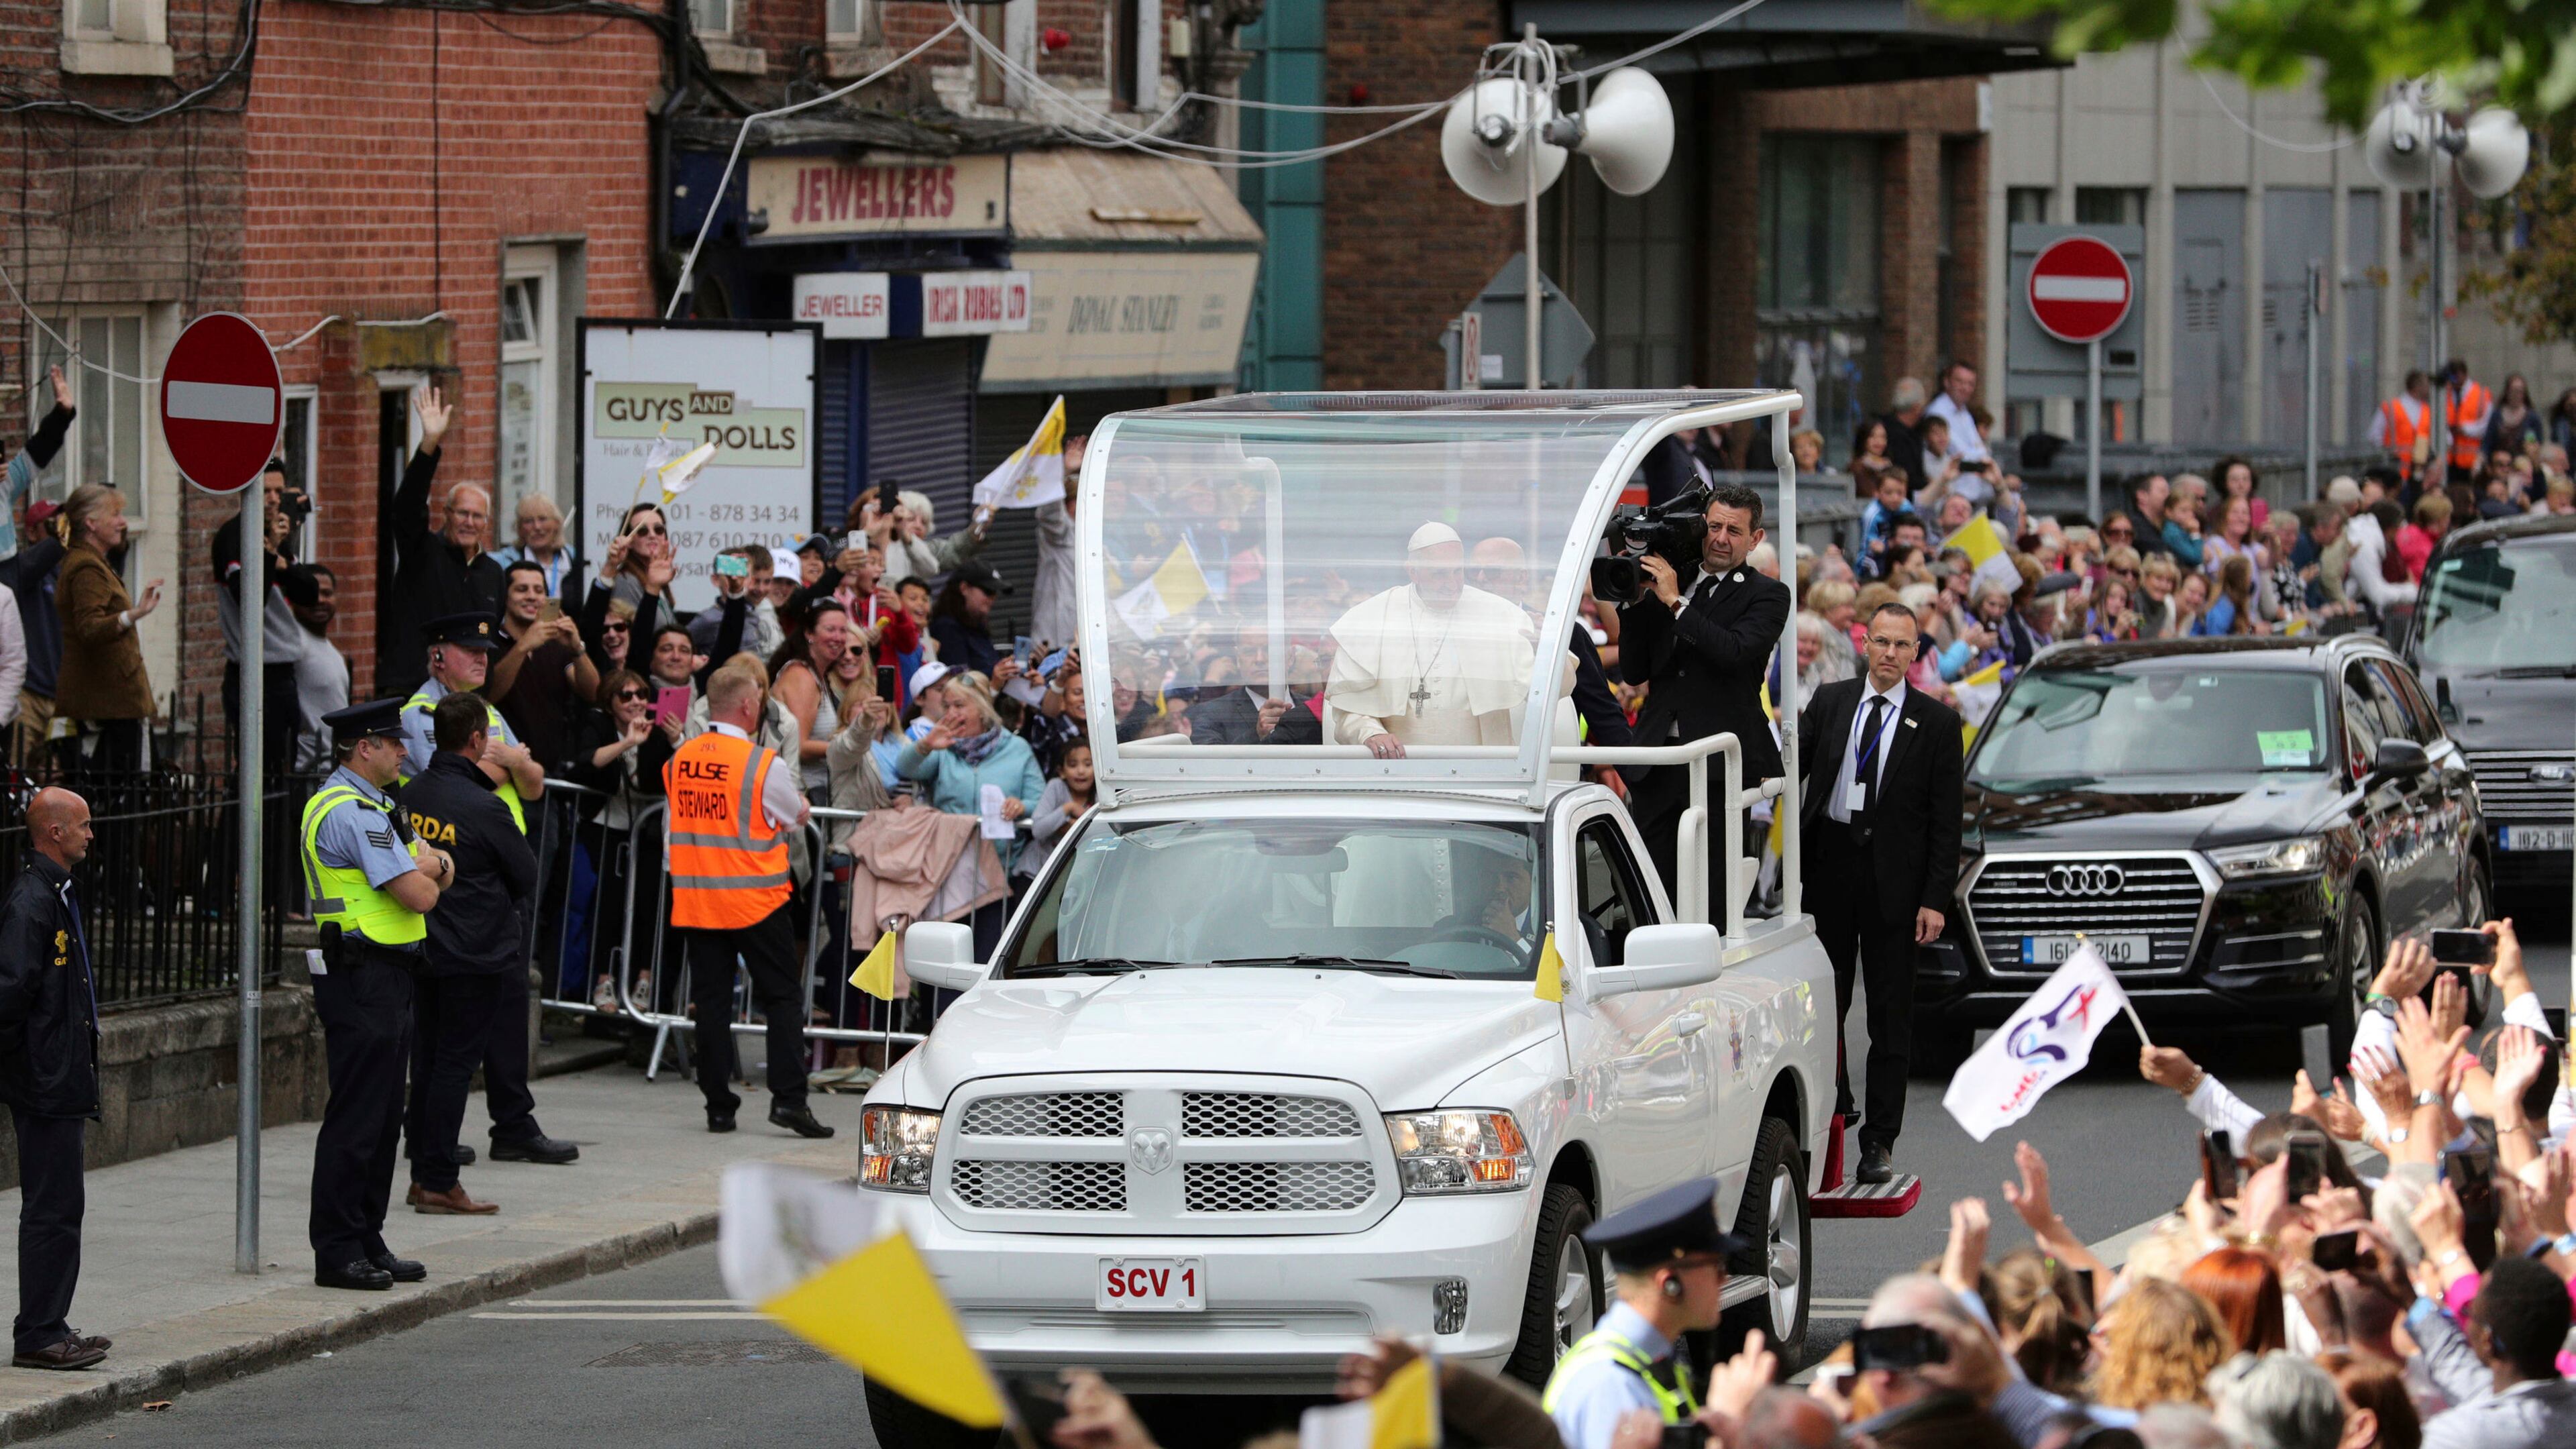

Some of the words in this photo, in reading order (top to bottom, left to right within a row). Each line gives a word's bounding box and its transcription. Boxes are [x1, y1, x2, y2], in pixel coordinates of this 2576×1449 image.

[791, 164, 957, 224] JEWELLERS
[800, 294, 883, 318] JEWELLER
[928, 286, 958, 323] IRISH
[963, 286, 1002, 321] RUBIES
[1009, 284, 1026, 319] LTD
[607, 398, 683, 421] GUYS
[690, 396, 732, 413] AND
[704, 426, 795, 449] DOLLS
[604, 444, 629, 457] Hair
[671, 504, 690, 520] 01
[710, 505, 743, 521] 878
[749, 505, 771, 521] 34
[777, 506, 799, 522] 34
[672, 532, 703, 547] 087
[709, 532, 743, 548] 610
[678, 761, 729, 782] PULSE
[678, 790, 727, 820] STEWARD
[410, 812, 458, 847] RDA
[1108, 1268, 1170, 1297] SCV
[1182, 1268, 1195, 1297] 1
